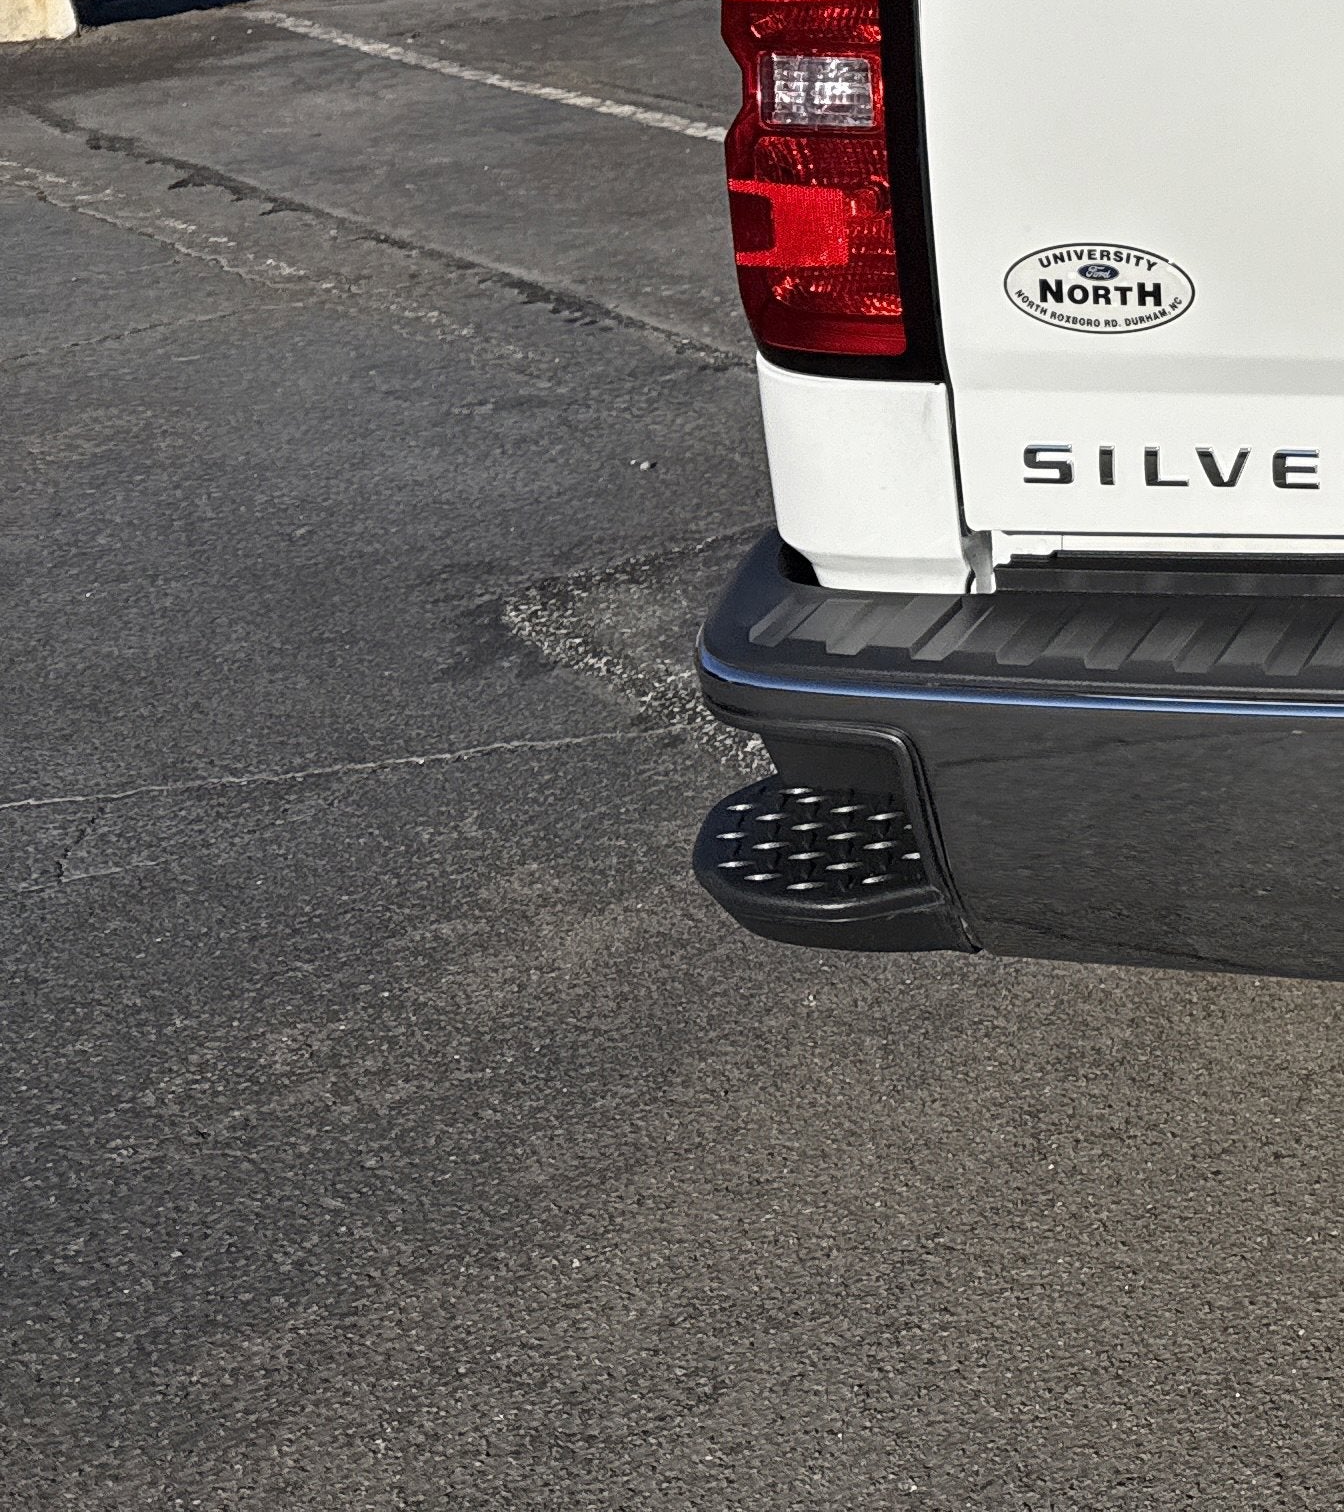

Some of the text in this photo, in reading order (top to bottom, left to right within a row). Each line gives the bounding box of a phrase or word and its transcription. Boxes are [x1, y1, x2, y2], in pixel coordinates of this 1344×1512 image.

[1038, 249, 1158, 272] UNIVERSITY
[1039, 278, 1162, 307] NORTH
[1015, 289, 1047, 316] NORTH
[1050, 311, 1100, 327] ROXBORO
[1170, 296, 1183, 311] NC
